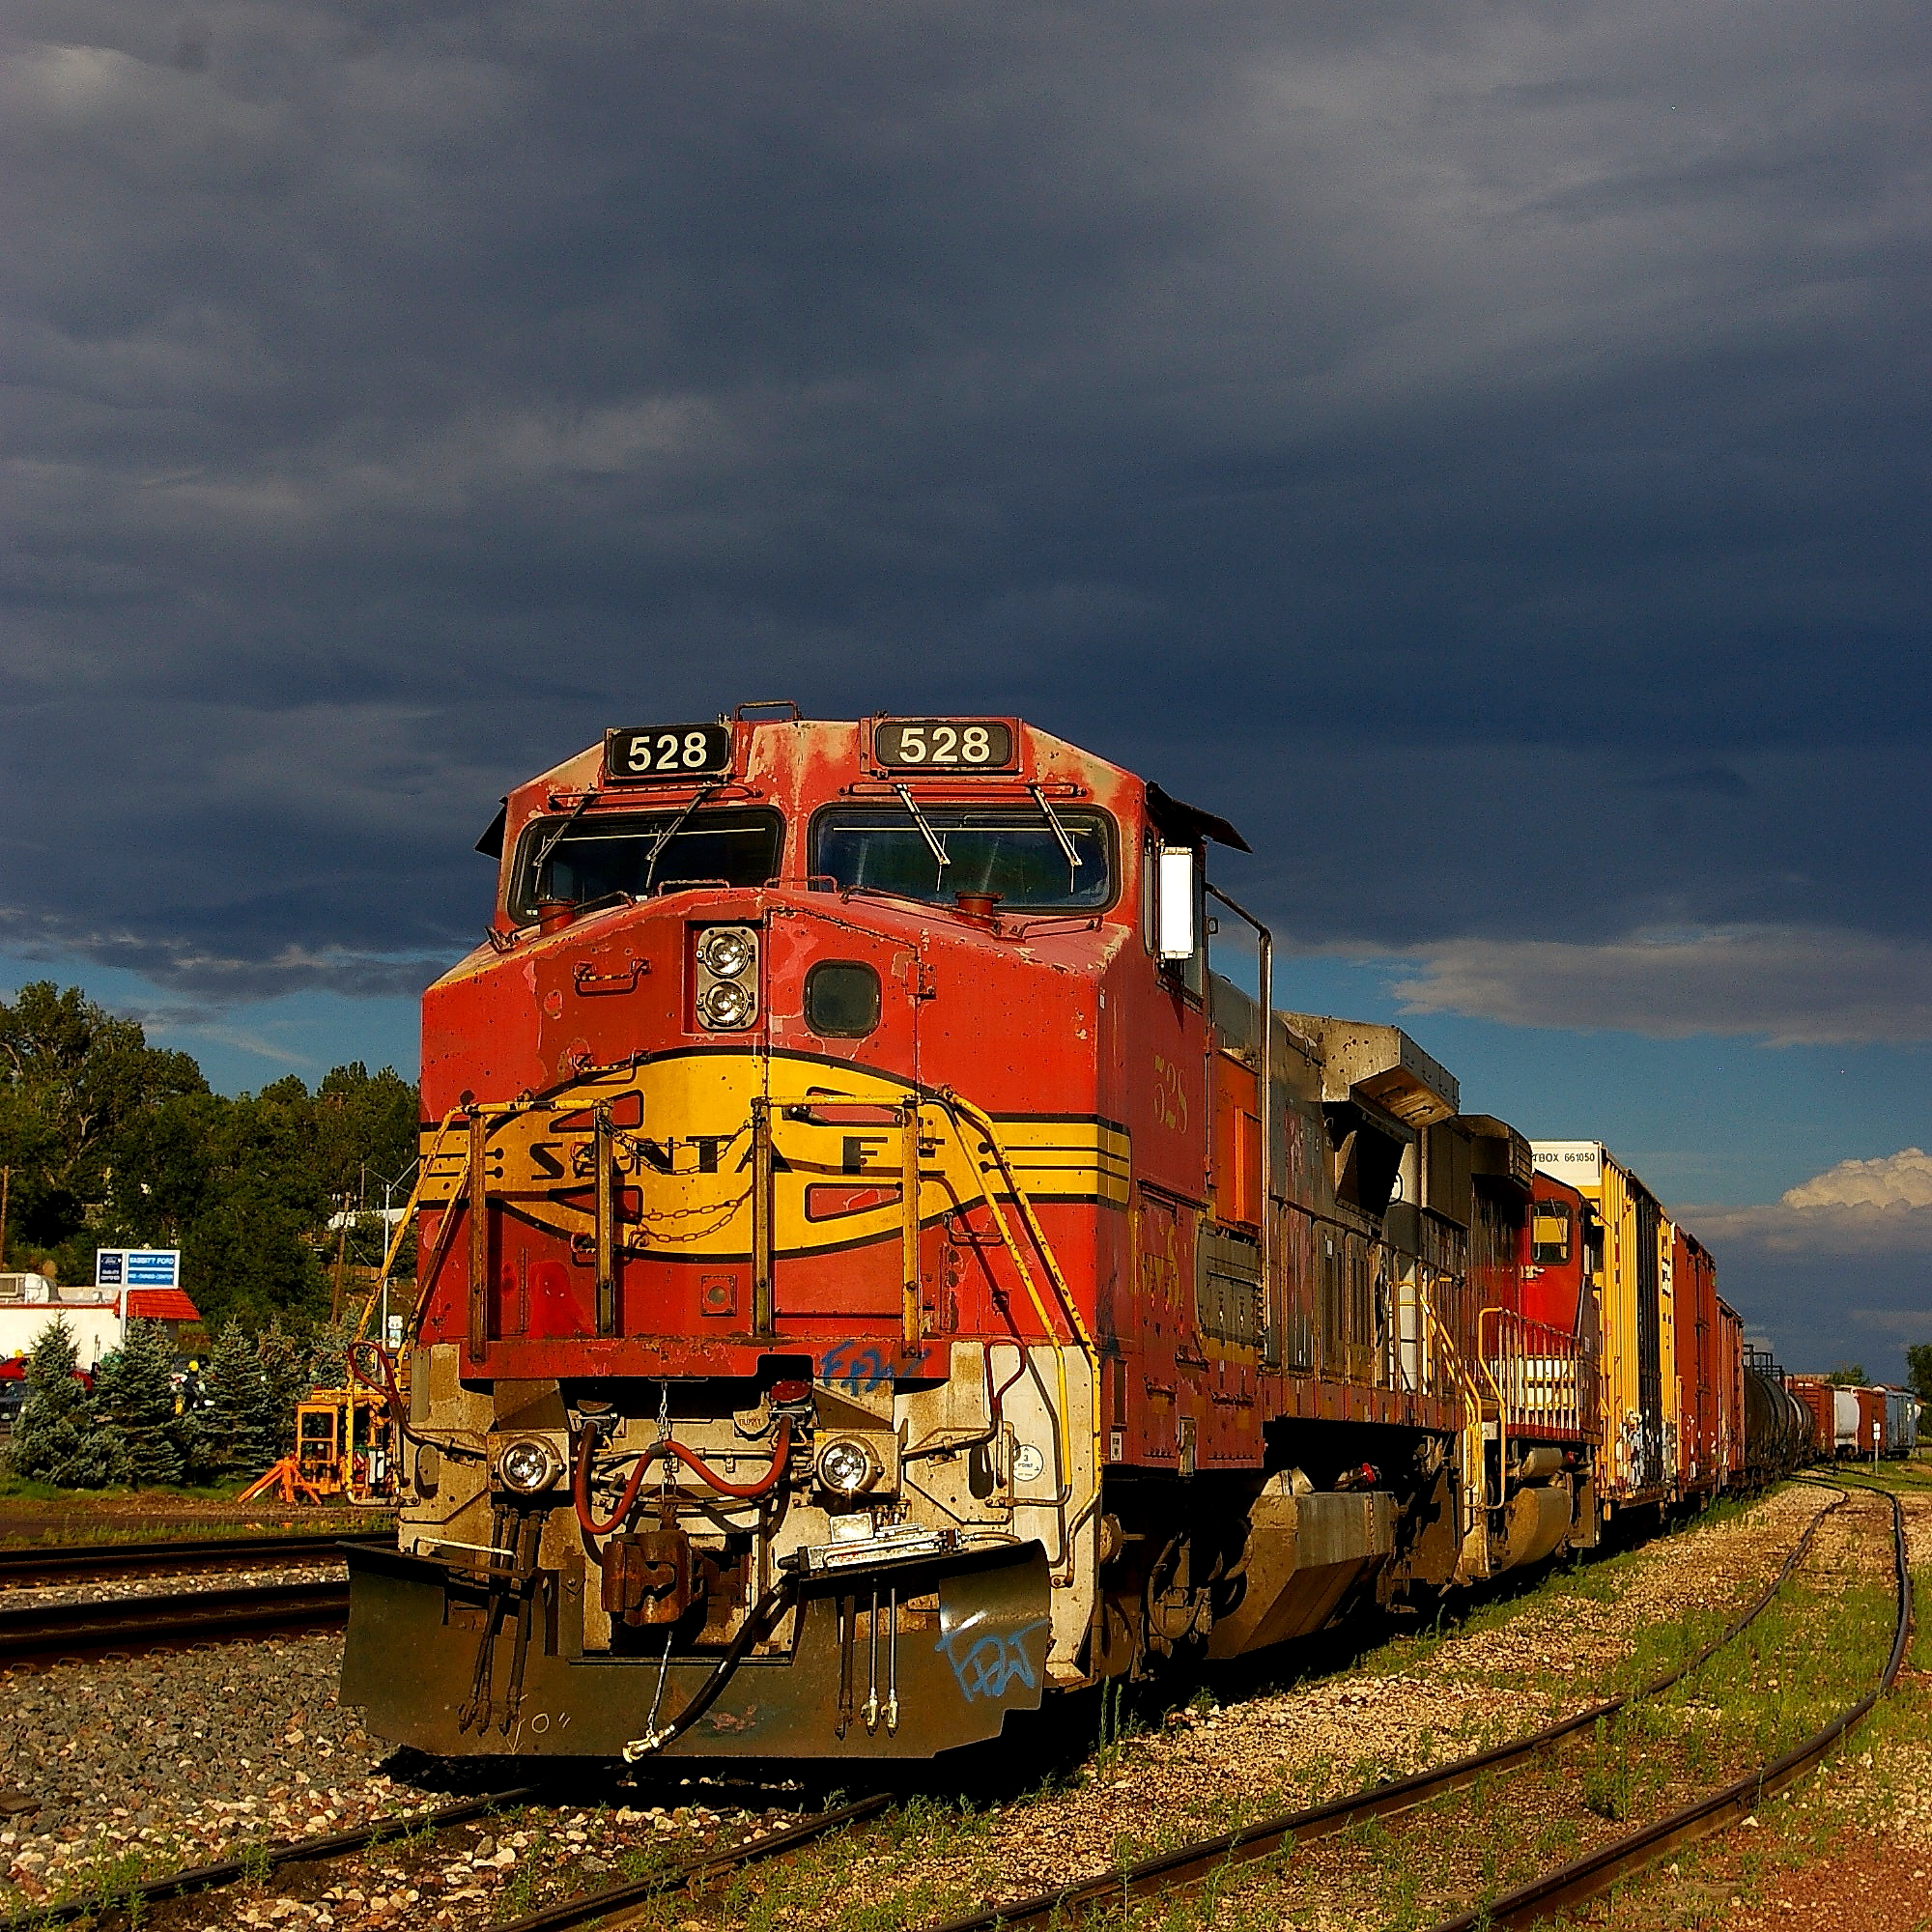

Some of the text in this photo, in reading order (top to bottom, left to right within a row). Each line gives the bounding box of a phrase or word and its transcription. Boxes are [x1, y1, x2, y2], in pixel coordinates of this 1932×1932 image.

[627, 731, 708, 772] 528
[898, 726, 991, 763] 528
[1564, 1152, 1596, 1162] 661050
